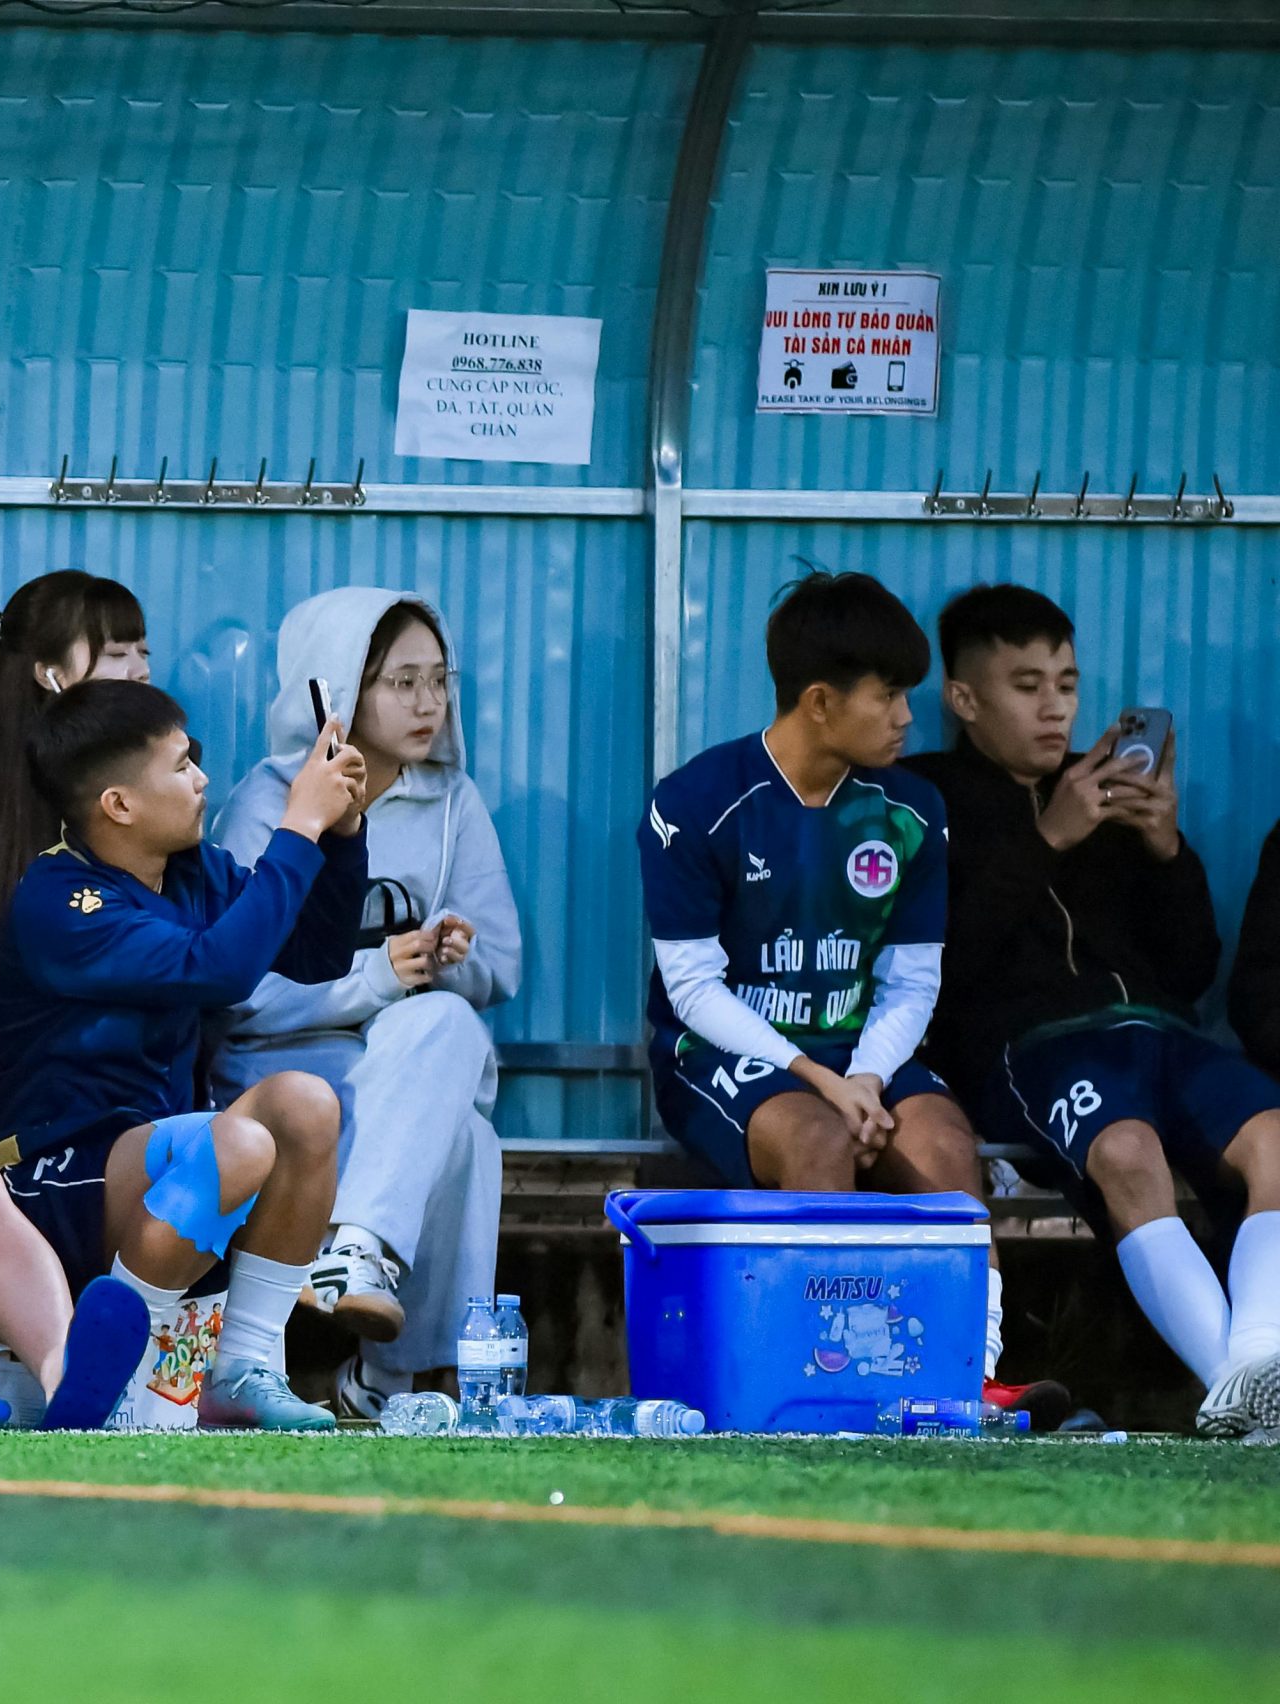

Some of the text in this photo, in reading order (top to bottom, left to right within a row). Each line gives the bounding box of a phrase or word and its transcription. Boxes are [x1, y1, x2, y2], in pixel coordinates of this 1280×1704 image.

[818, 282, 840, 297] XIN
[793, 308, 831, 328] LÒNG
[837, 311, 855, 333] TỰ
[860, 308, 890, 330] BẢO
[463, 332, 540, 349] HOTLINE
[784, 332, 912, 356] TÀI SẢN CÁ NHÂN
[426, 377, 471, 393] CUNG
[761, 395, 927, 407] PLEASE TAKE OF YOUR BELONGINGS
[1048, 1079, 1102, 1148] 28
[804, 1275, 884, 1301] MATSU
